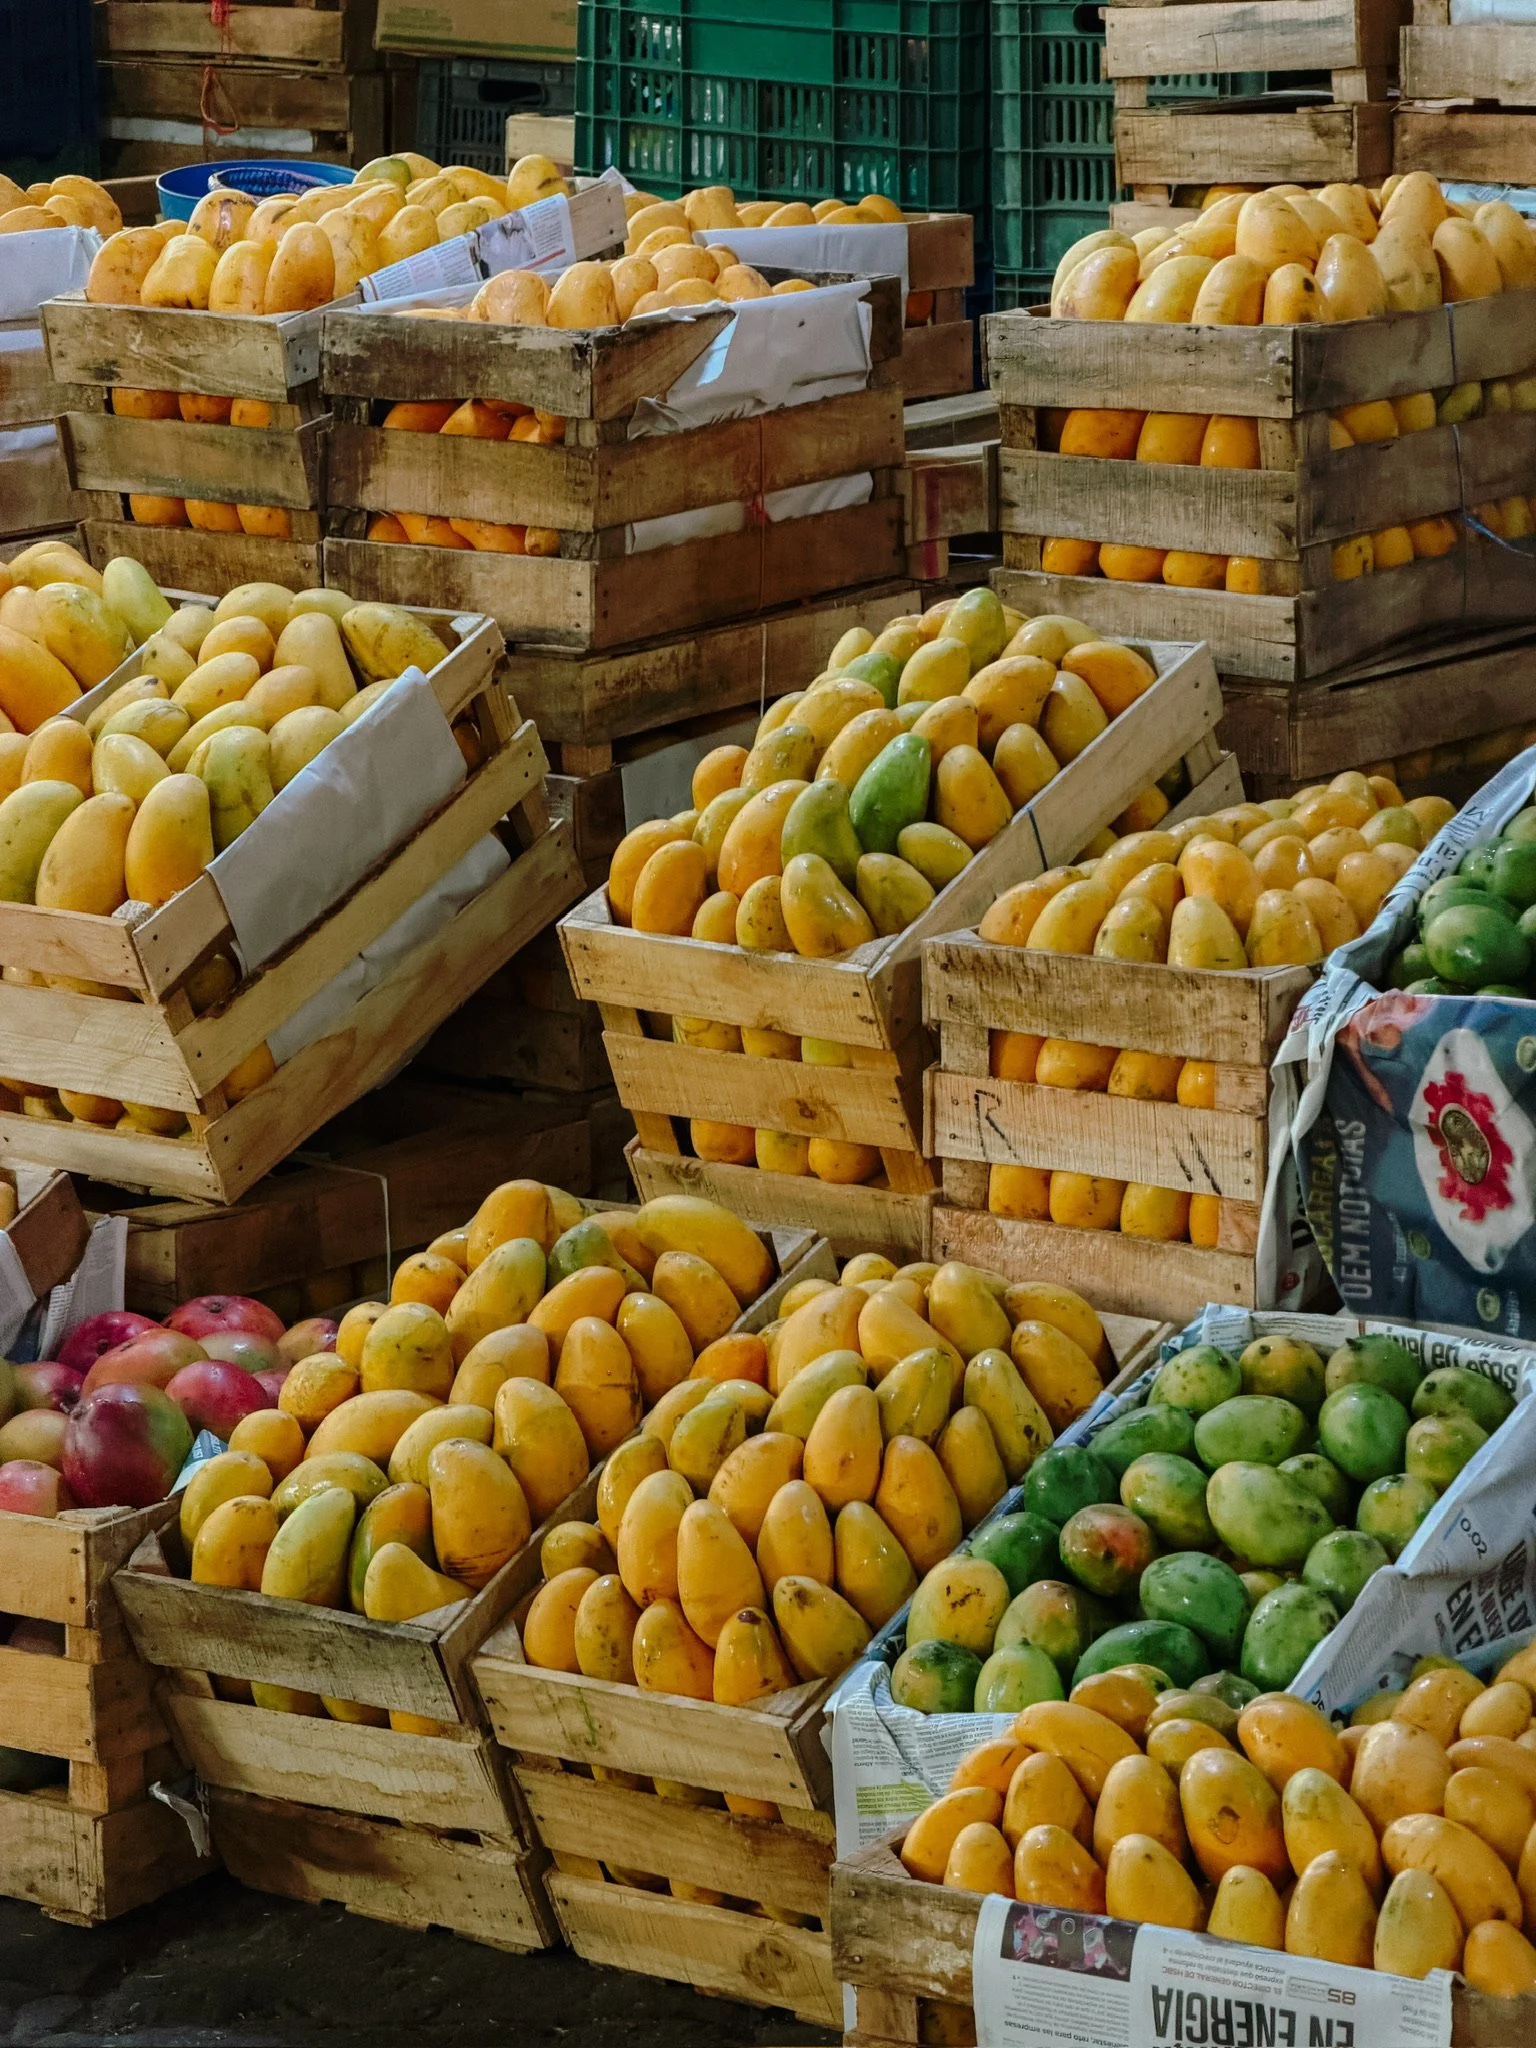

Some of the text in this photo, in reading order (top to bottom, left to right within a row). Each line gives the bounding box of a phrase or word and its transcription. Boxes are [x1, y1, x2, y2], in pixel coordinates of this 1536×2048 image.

[1447, 1580, 1475, 1633] EN
[1152, 1984, 1297, 2048] ENERGÍA
[1310, 2013, 1355, 2048] EN
